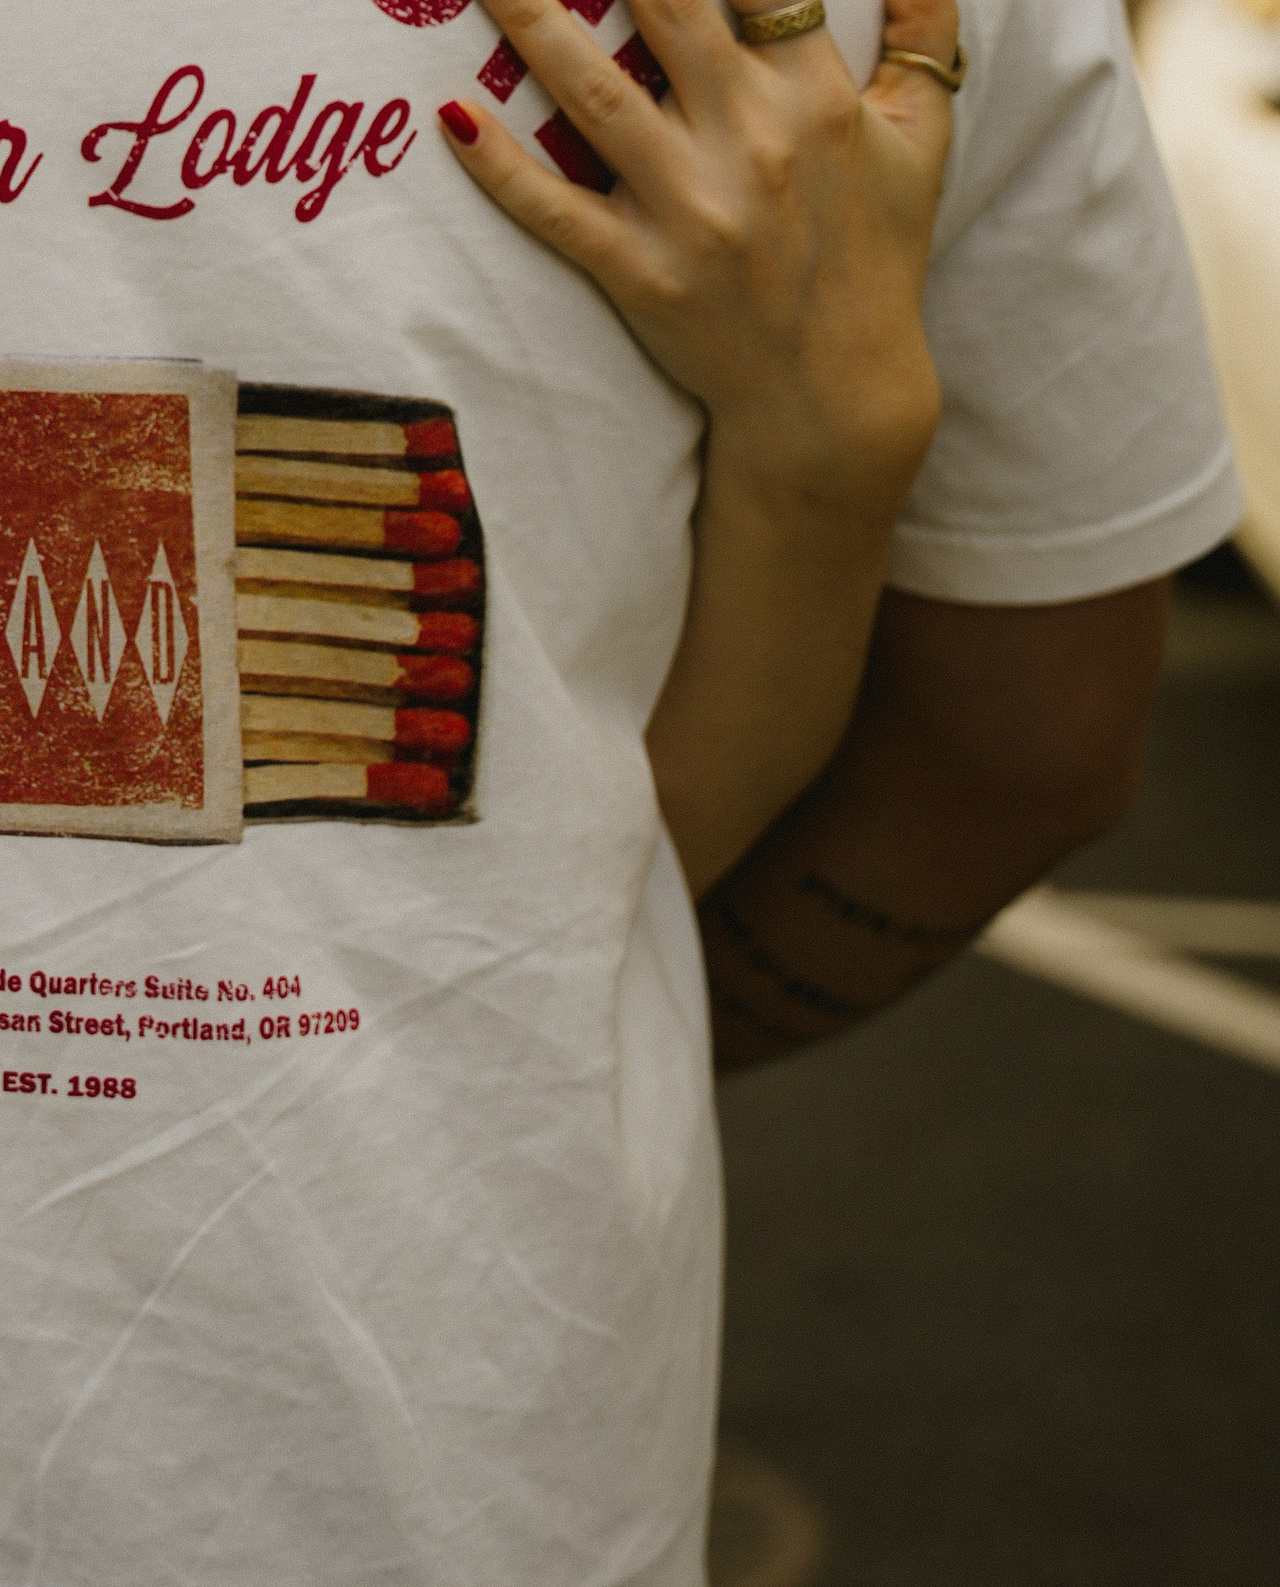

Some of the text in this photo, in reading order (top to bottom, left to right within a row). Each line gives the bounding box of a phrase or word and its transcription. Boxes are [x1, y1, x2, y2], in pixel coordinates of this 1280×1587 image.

[81, 64, 418, 223] Lodge
[29, 970, 137, 999] Quarters
[144, 975, 209, 1002] Suite
[217, 980, 255, 1002] No.
[262, 974, 302, 1001] 404
[48, 1009, 131, 1042] Street,
[138, 1015, 252, 1045] Portland,
[259, 1014, 291, 1039] OR
[298, 1007, 361, 1036] 97209
[2, 1070, 137, 1100] EST. 1988
